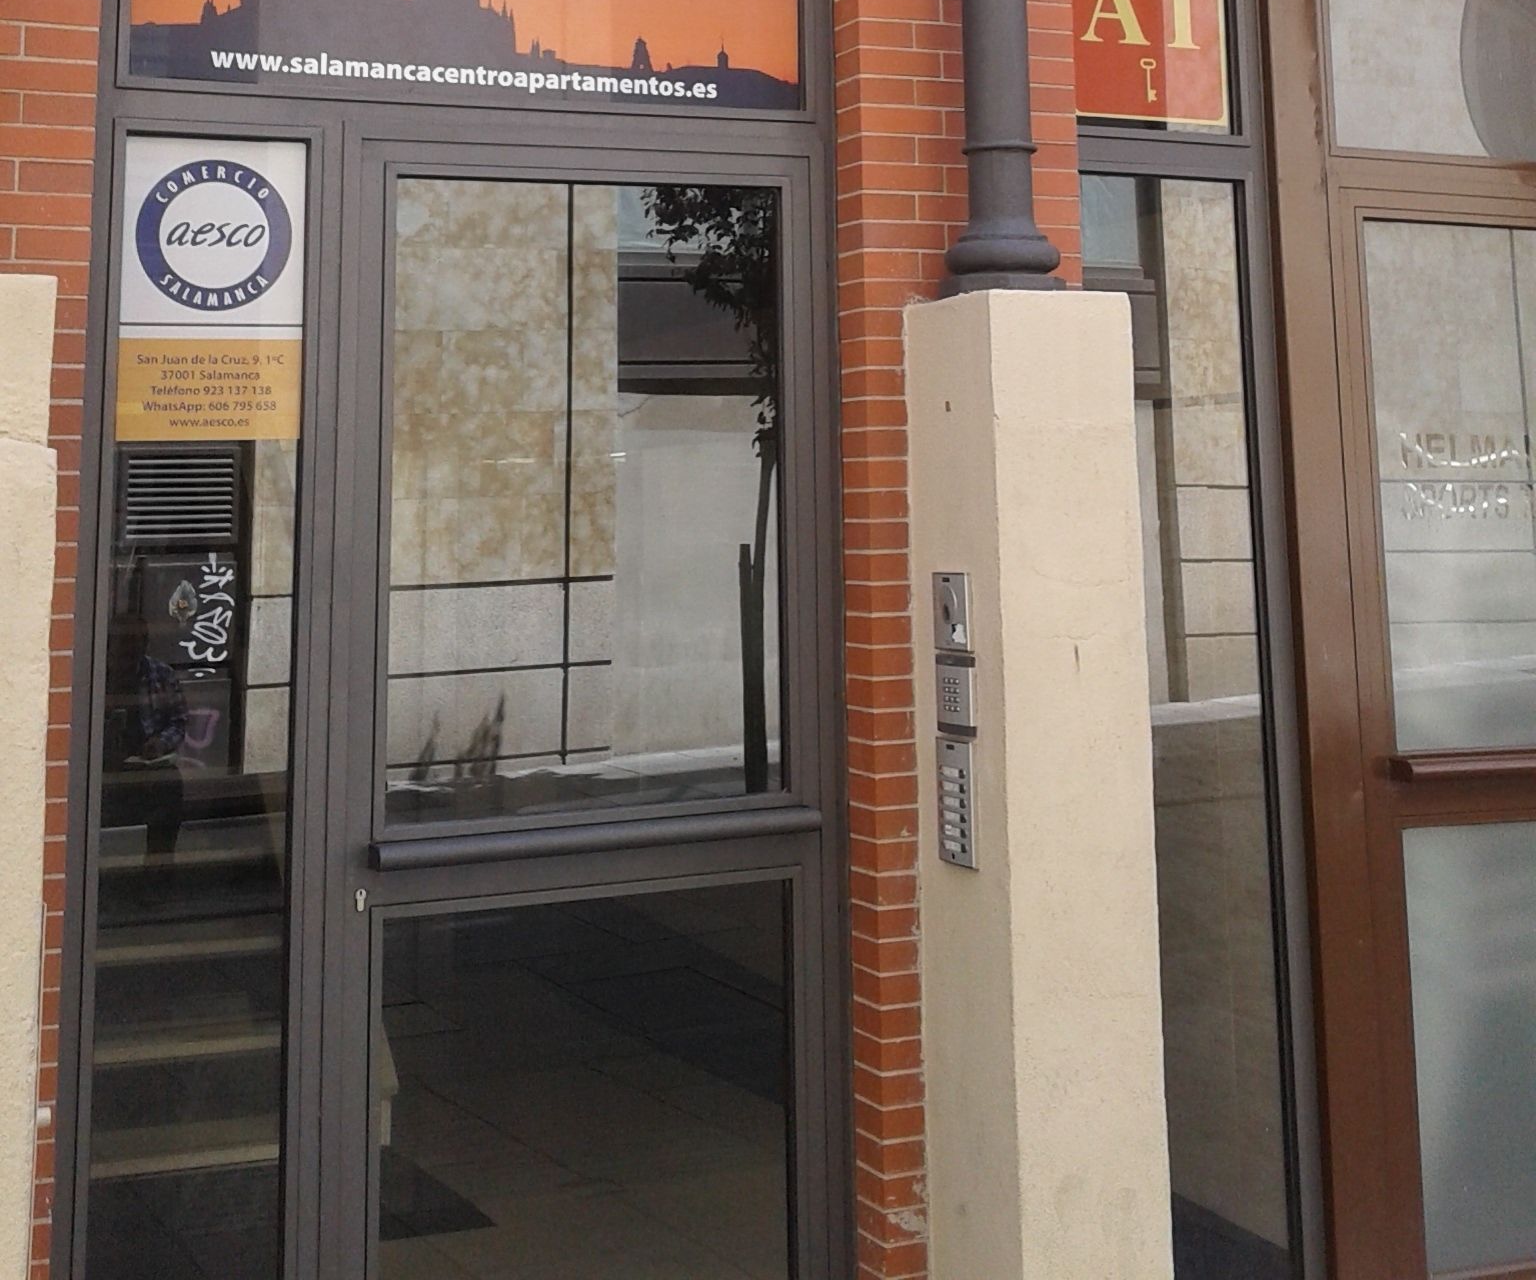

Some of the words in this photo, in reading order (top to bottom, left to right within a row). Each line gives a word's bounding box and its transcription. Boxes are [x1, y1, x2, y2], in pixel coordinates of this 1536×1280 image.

[211, 49, 718, 100] www.salamancacentroapartamentos.es
[155, 165, 270, 204] COMERCIO
[166, 221, 266, 248] aesco
[160, 274, 270, 307] SALAMANCA
[137, 354, 158, 365] San
[160, 354, 188, 365] Juan
[191, 354, 206, 365] de
[208, 354, 218, 365] la
[160, 370, 196, 380] 37001
[199, 370, 261, 380] Salamanca
[150, 385, 200, 396] Teléfono
[202, 386, 224, 396] 923
[228, 386, 249, 396] 137
[252, 386, 272, 396] 138
[142, 400, 206, 413] WhatsApp:
[208, 401, 229, 411] 606
[232, 401, 253, 411] 795
[255, 401, 277, 411] 658
[169, 417, 250, 428] www.aesco.es
